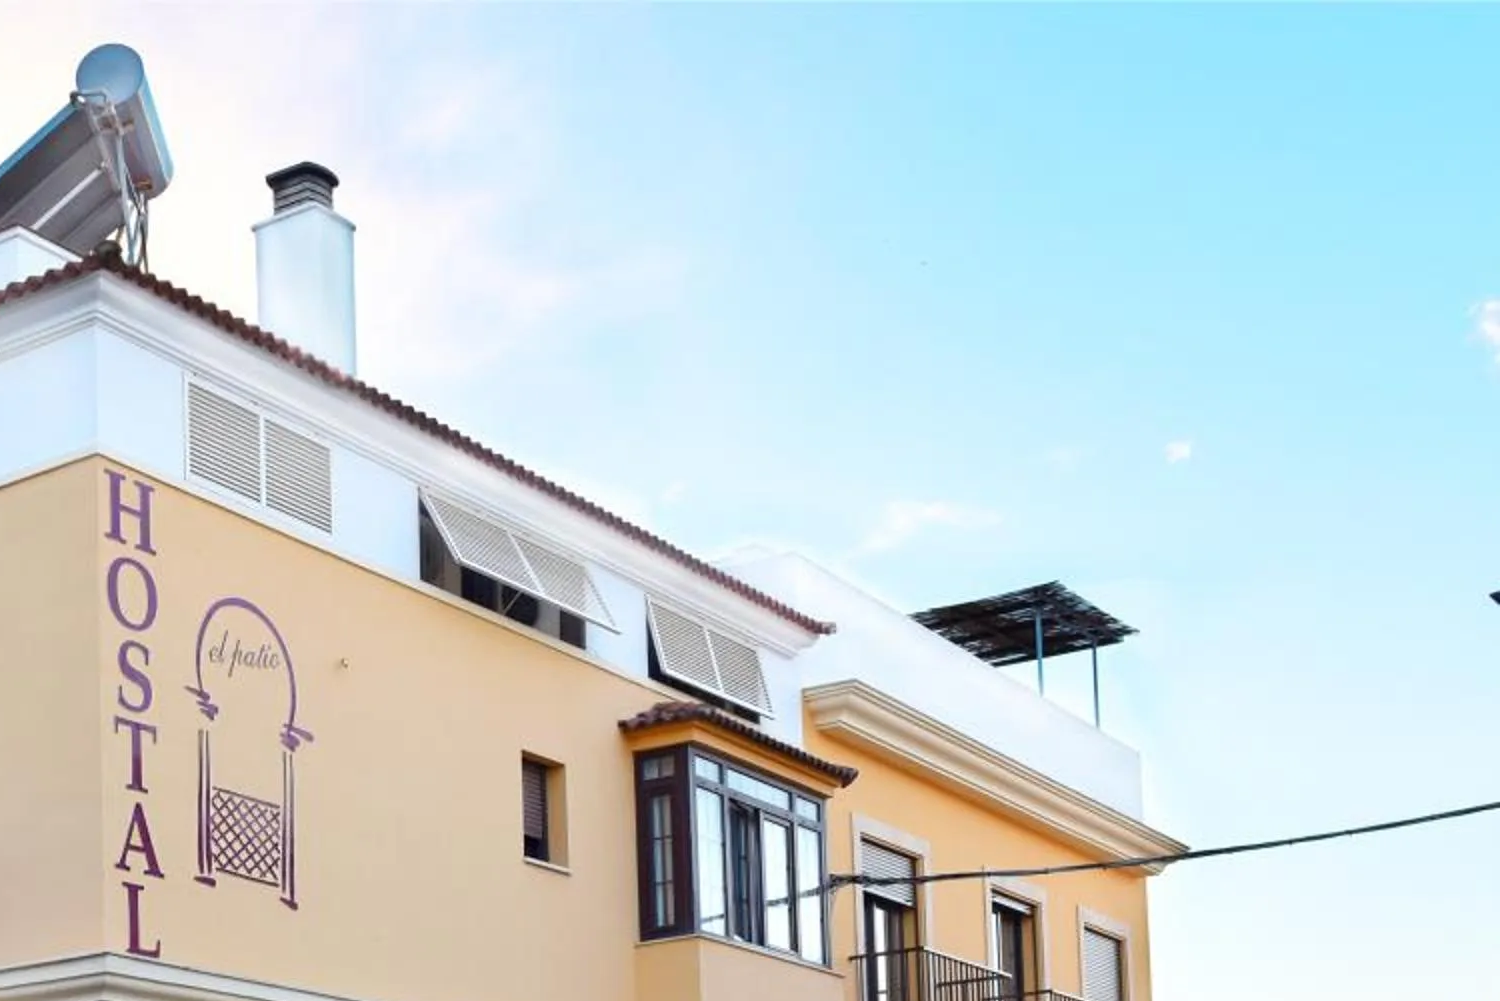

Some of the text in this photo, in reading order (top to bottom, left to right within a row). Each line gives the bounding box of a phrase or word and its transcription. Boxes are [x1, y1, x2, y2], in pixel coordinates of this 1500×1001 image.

[103, 468, 165, 959] HOSTAL
[208, 629, 281, 678] el patio
